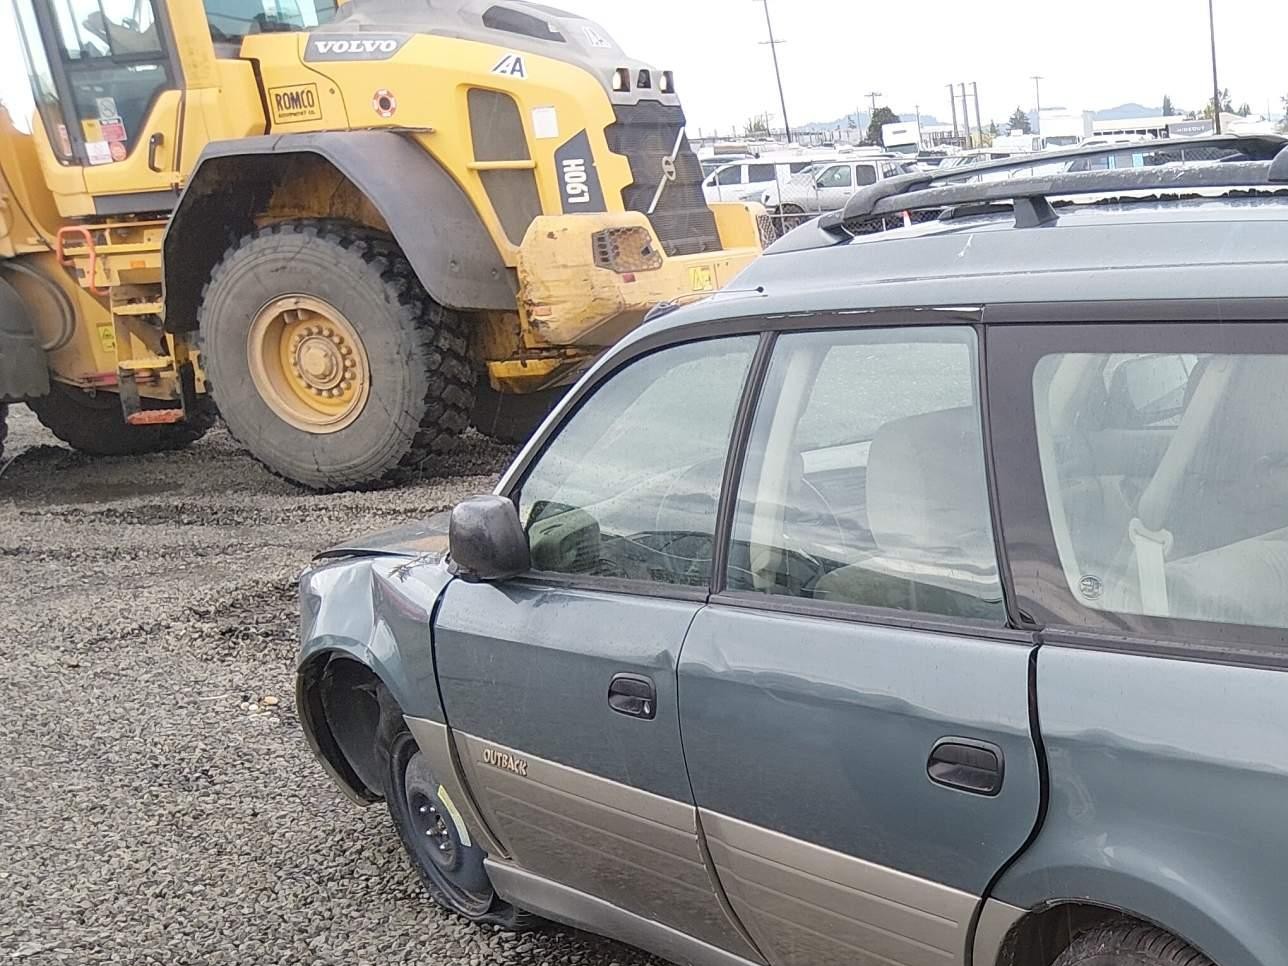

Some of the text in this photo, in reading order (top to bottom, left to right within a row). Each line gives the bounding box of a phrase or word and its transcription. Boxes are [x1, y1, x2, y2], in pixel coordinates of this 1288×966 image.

[314, 40, 397, 53] VOLVO
[274, 89, 316, 112] ROMCO
[562, 159, 590, 203] L90H
[482, 748, 528, 776] OUTBACK
